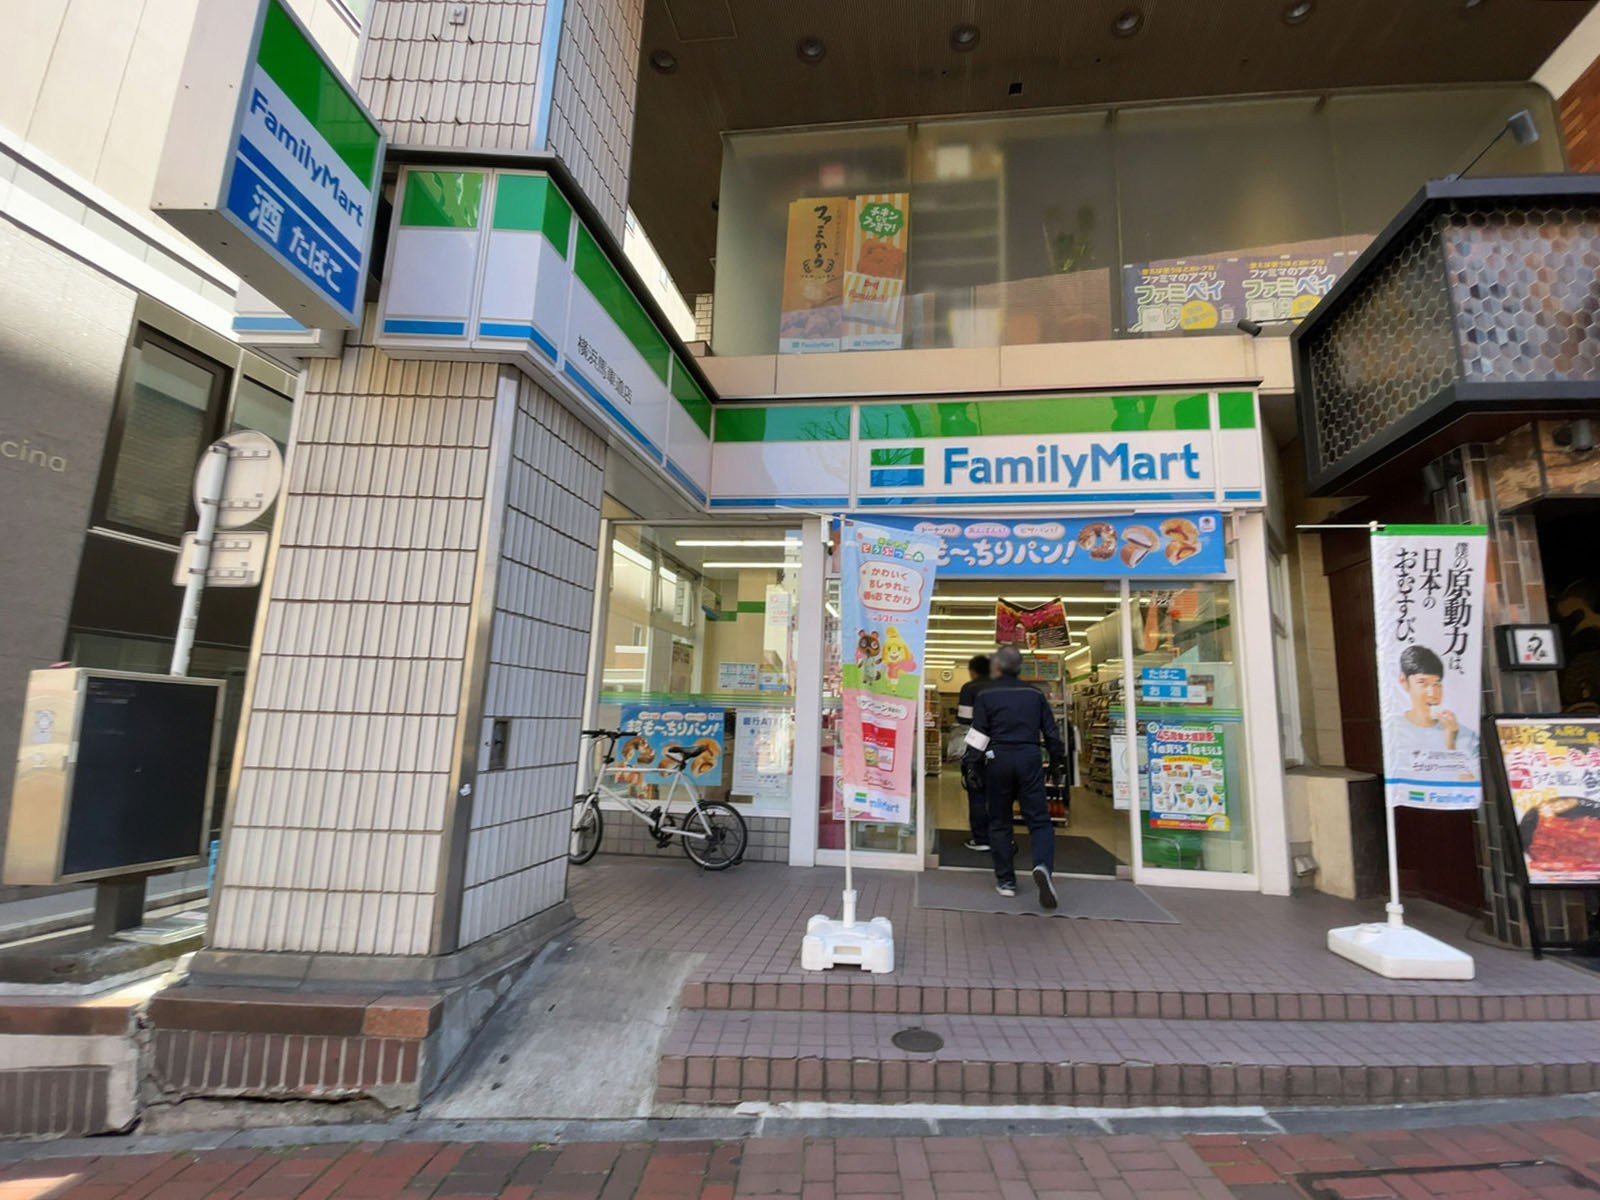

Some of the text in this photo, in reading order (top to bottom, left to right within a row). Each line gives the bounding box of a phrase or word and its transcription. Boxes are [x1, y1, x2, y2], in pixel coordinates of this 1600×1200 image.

[250, 87, 364, 227] FamilyMart
[870, 206, 899, 221] チキン
[249, 184, 342, 293] 酒 たばこ
[1141, 271, 1218, 285] ファミマのアプリ
[1249, 266, 1328, 280] ファミマのアプリ
[1135, 280, 1226, 305] ファミペイ
[1242, 274, 1336, 300] ファミペイ
[577, 334, 633, 405] 横浜馬車道店
[944, 442, 1201, 488] FamilyMart
[871, 567, 909, 580] かわいく
[1419, 548, 1442, 610] 日本の
[1394, 547, 1418, 643] おむすび。
[1149, 669, 1180, 679] たばこ
